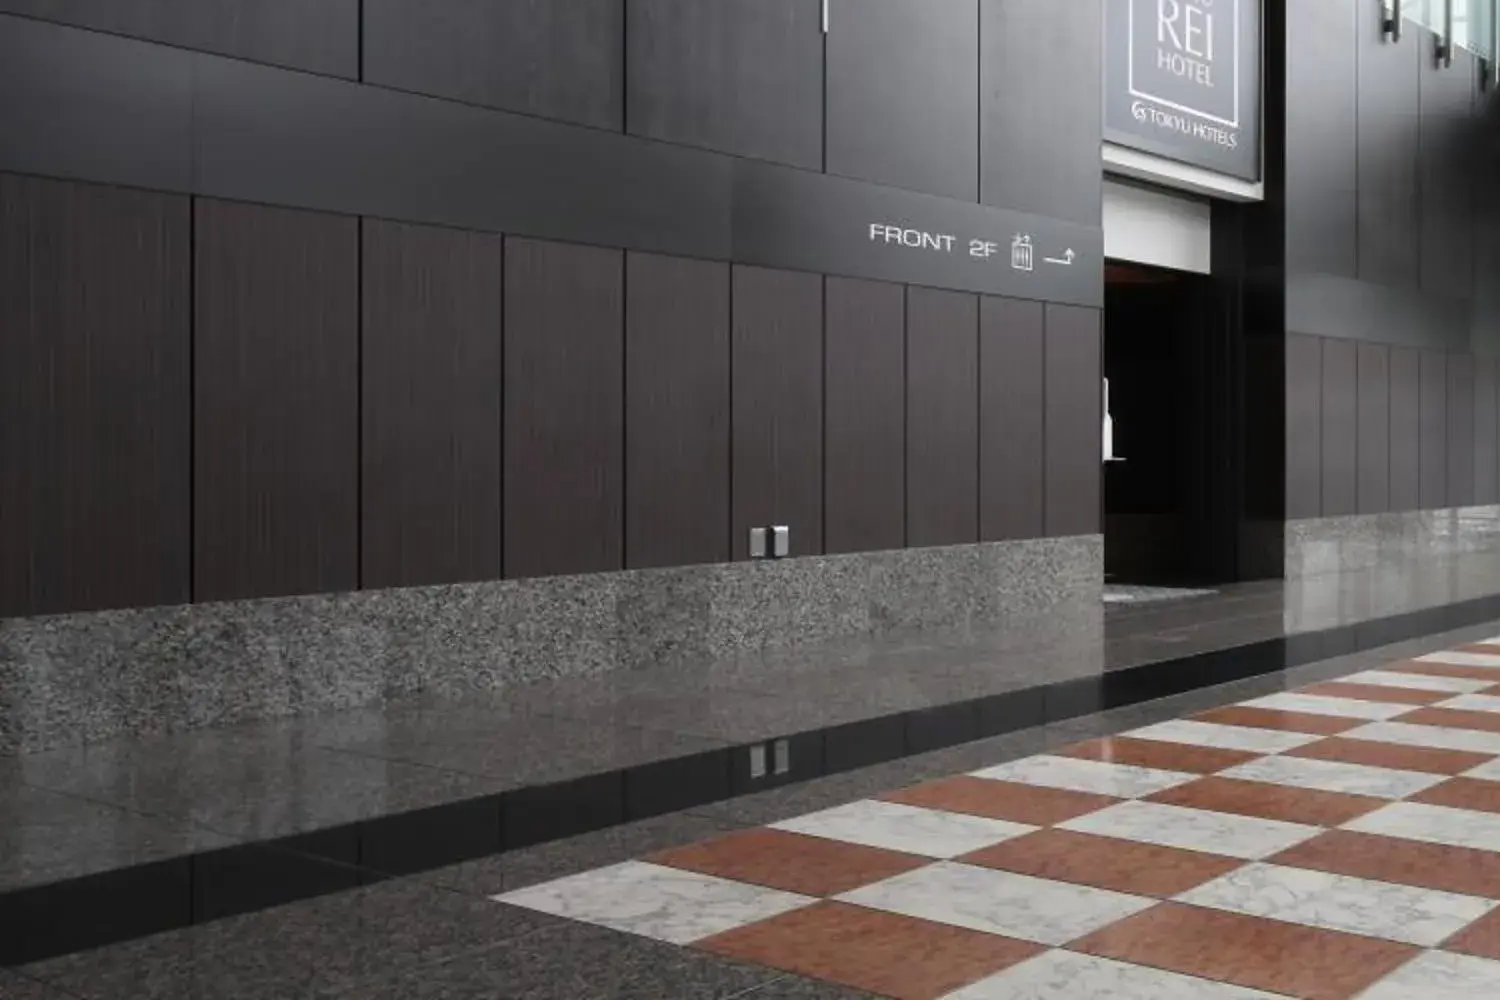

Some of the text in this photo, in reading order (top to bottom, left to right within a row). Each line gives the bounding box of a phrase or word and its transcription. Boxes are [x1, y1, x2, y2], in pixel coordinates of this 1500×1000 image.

[1158, 47, 1215, 87] HOTEL
[1151, 109, 1238, 149] TOKYU HOTELS
[869, 223, 998, 258] FRONT 2F
